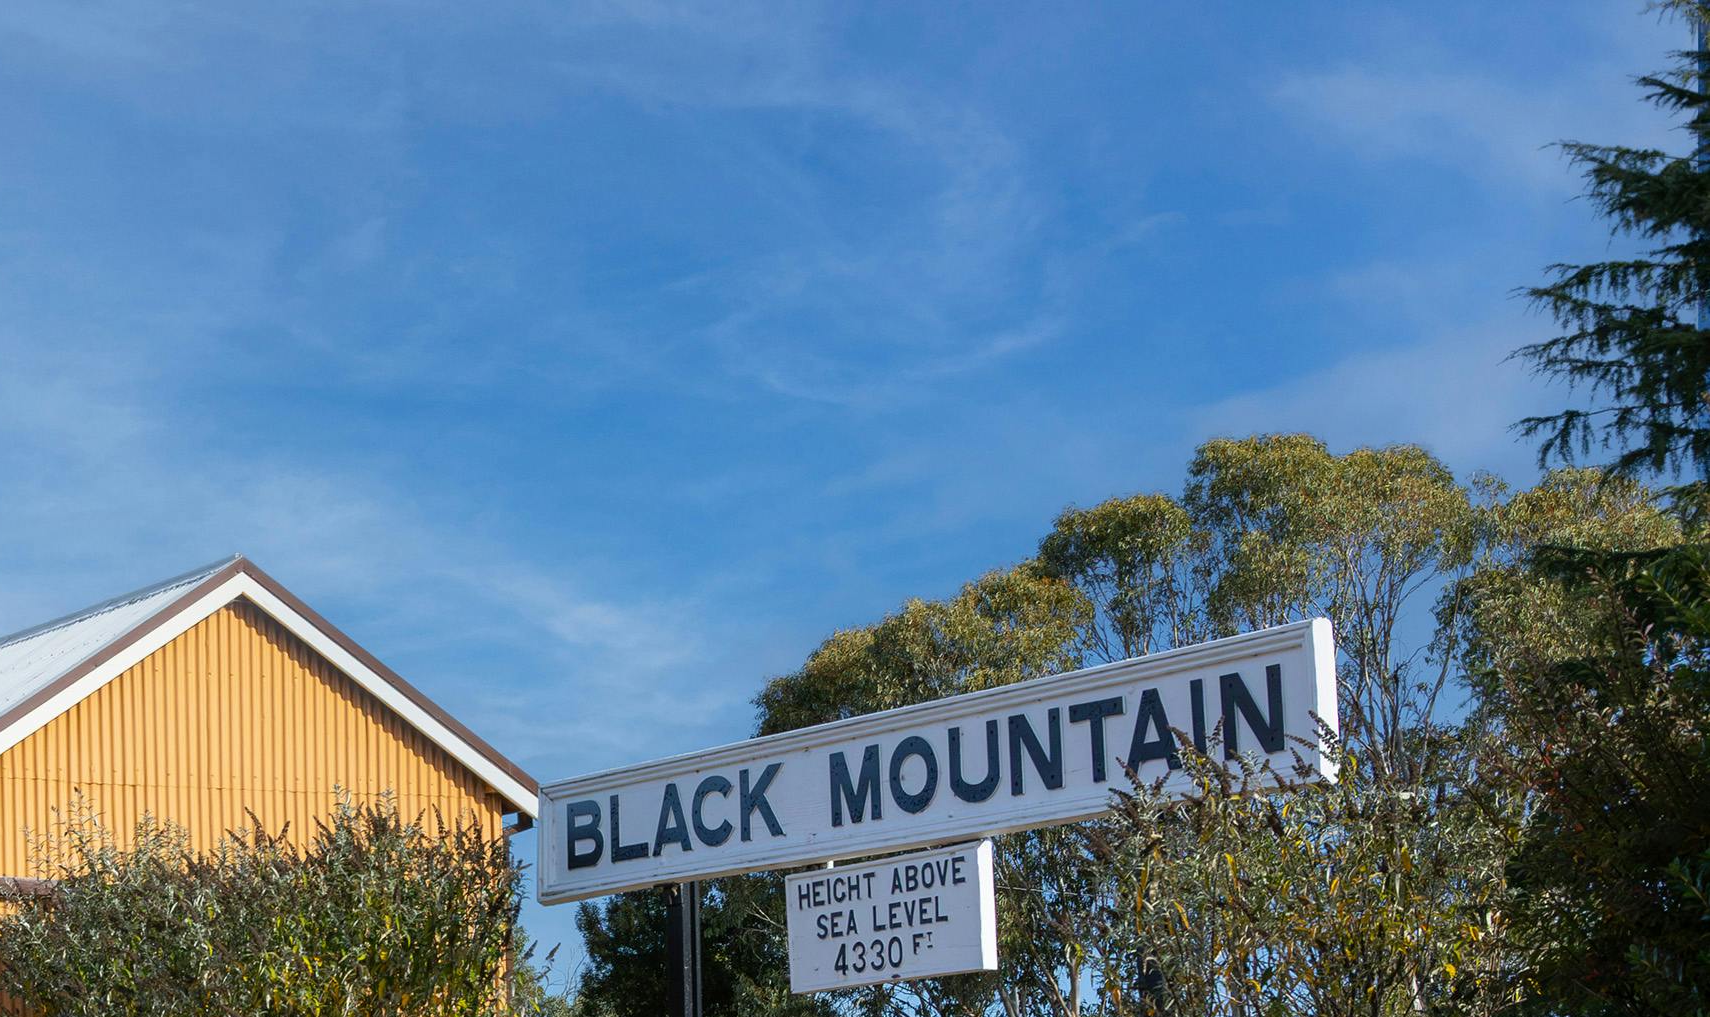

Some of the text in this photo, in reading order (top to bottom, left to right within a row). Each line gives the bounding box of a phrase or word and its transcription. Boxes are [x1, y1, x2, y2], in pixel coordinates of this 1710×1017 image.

[567, 663, 1285, 870] BLACK MOUNTAIN
[798, 856, 966, 910] HEIGHT ABOVE
[816, 896, 948, 939] SEA LEVEL
[834, 936, 903, 975] 4330
